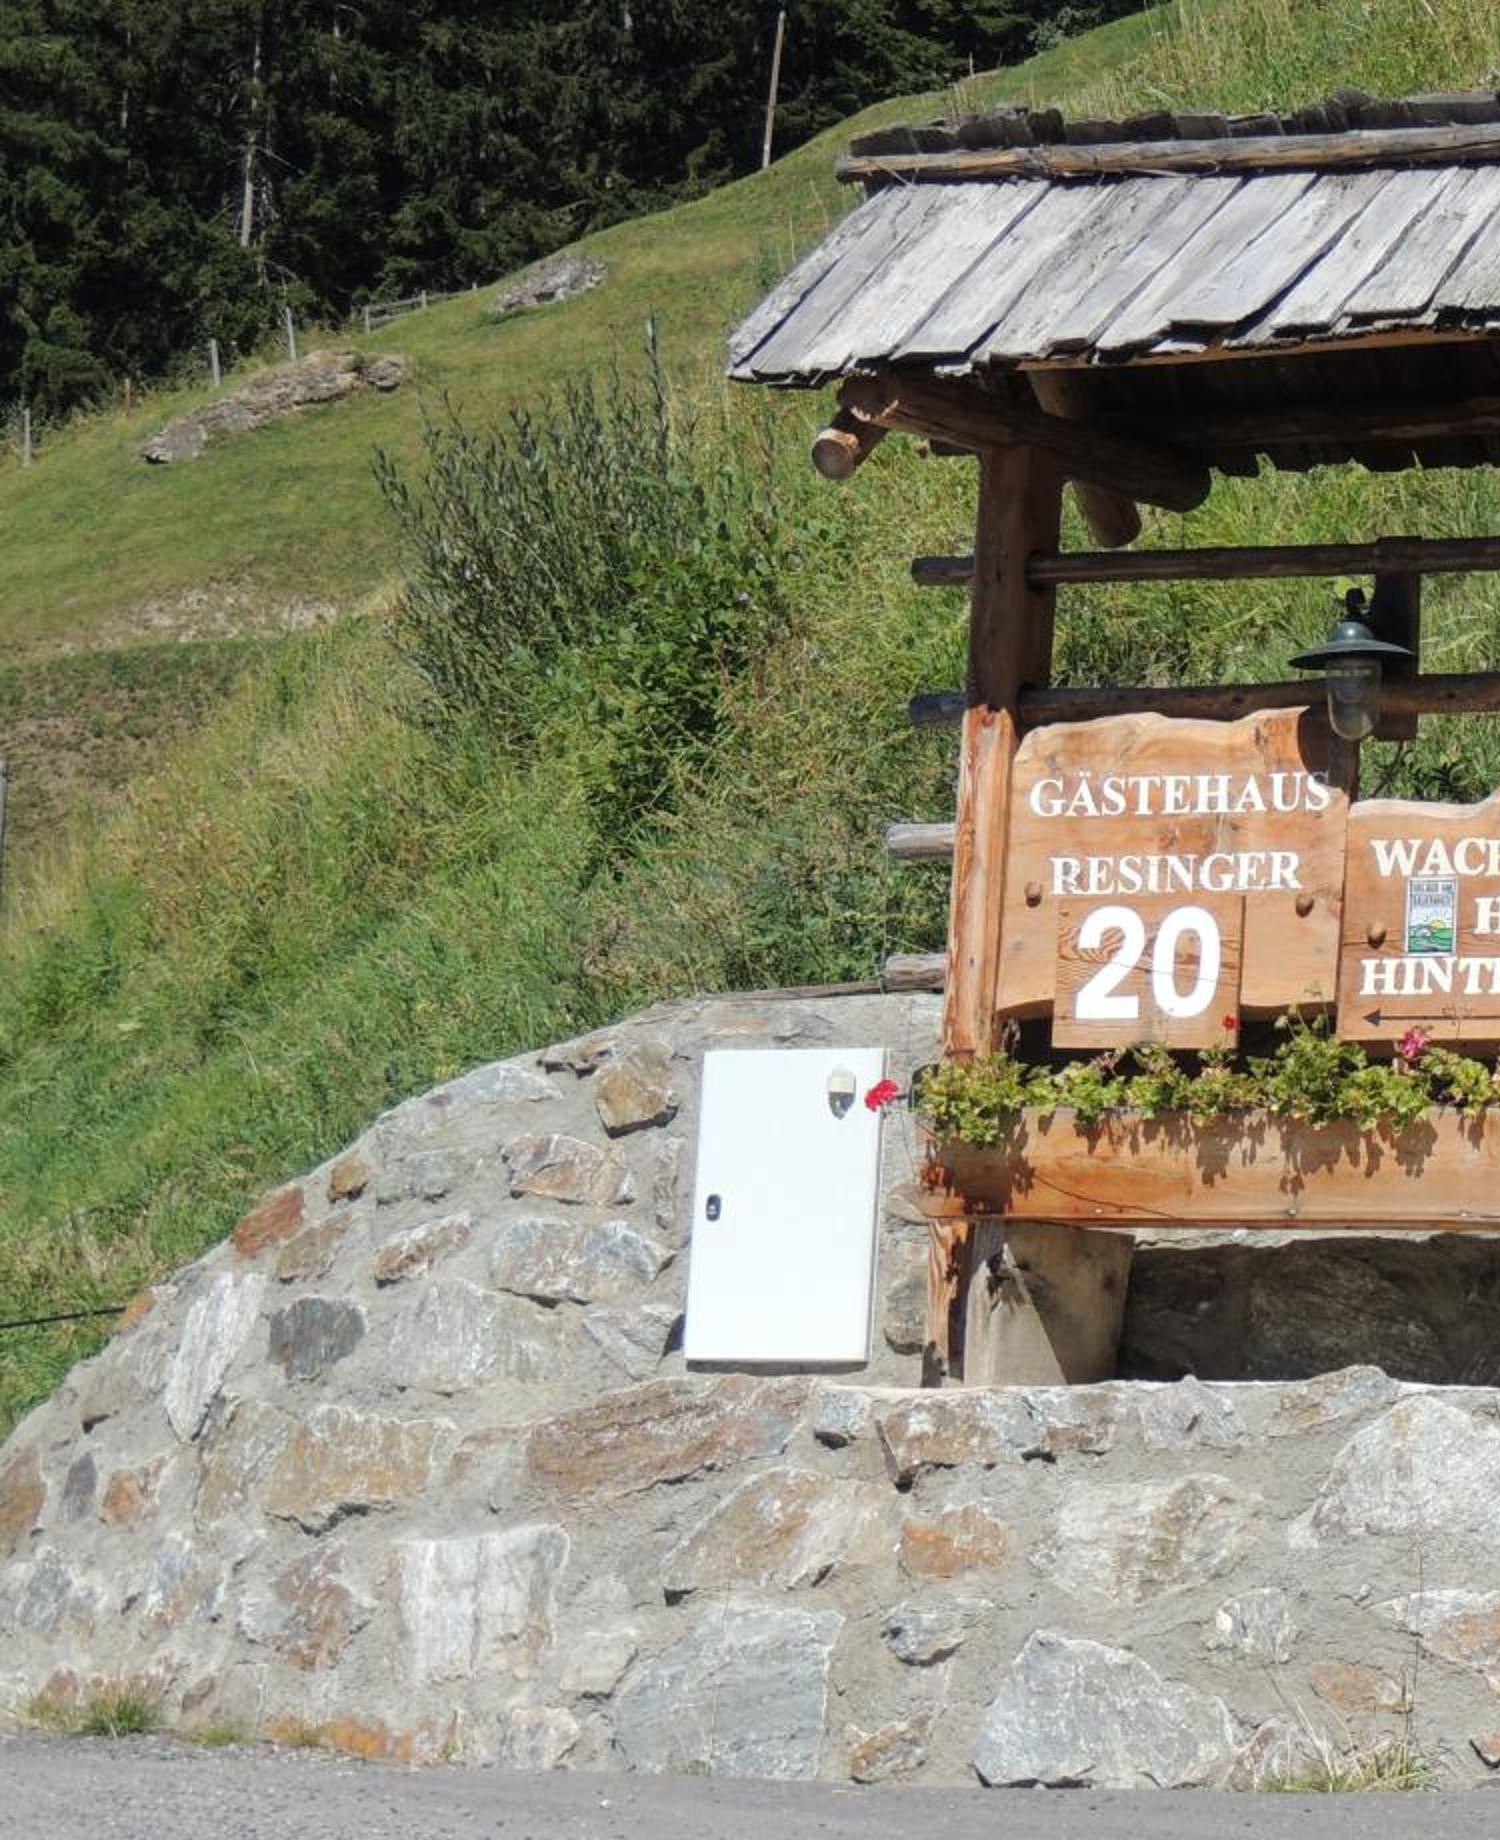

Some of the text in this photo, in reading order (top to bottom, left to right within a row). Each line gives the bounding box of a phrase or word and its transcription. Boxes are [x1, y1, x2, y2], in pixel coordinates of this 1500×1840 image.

[1029, 771, 1331, 817] GÄSTEHAUS
[1050, 852, 1303, 895] RESINGER
[1075, 906, 1222, 1020] 20
